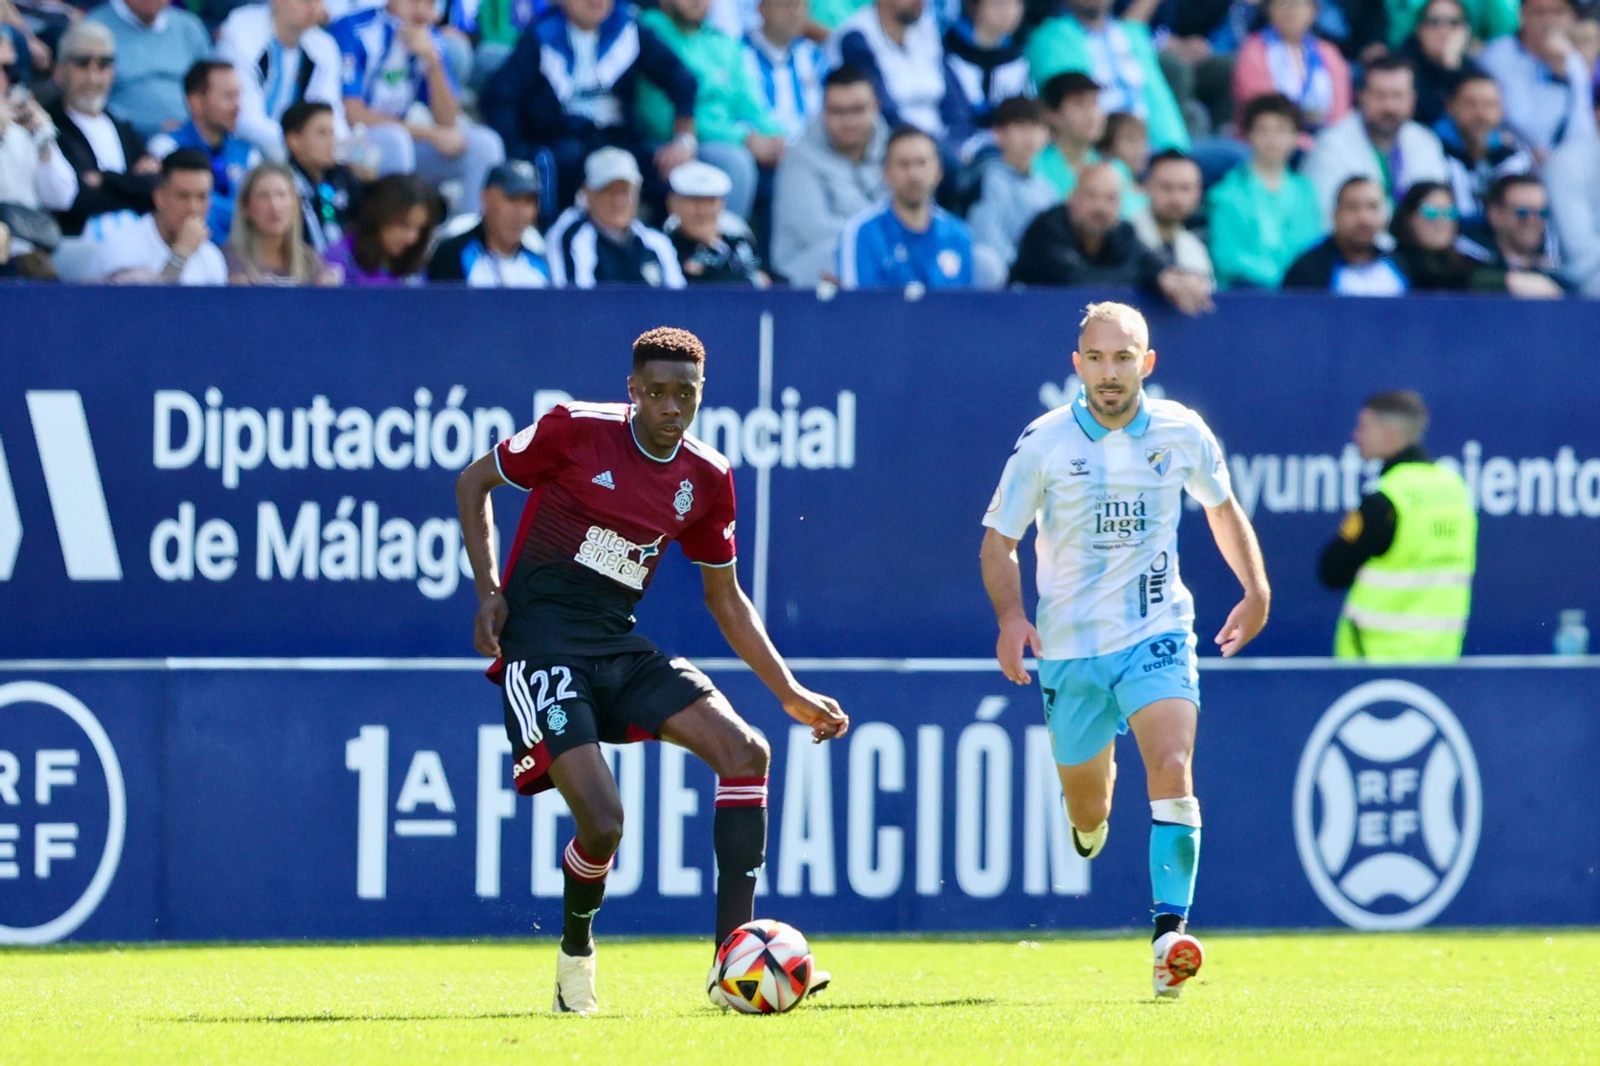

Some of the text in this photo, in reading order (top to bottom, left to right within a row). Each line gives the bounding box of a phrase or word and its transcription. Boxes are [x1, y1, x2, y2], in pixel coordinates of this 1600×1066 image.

[153, 384, 515, 490] Diputación
[1186, 439, 1600, 522] yuntiento
[1094, 512, 1147, 539] laga
[1104, 492, 1147, 518] má
[149, 501, 239, 581] de
[586, 525, 636, 558] alter
[1142, 654, 1187, 673] trafilex
[530, 665, 577, 712] 22
[475, 694, 1092, 899] FEDEACIÓN
